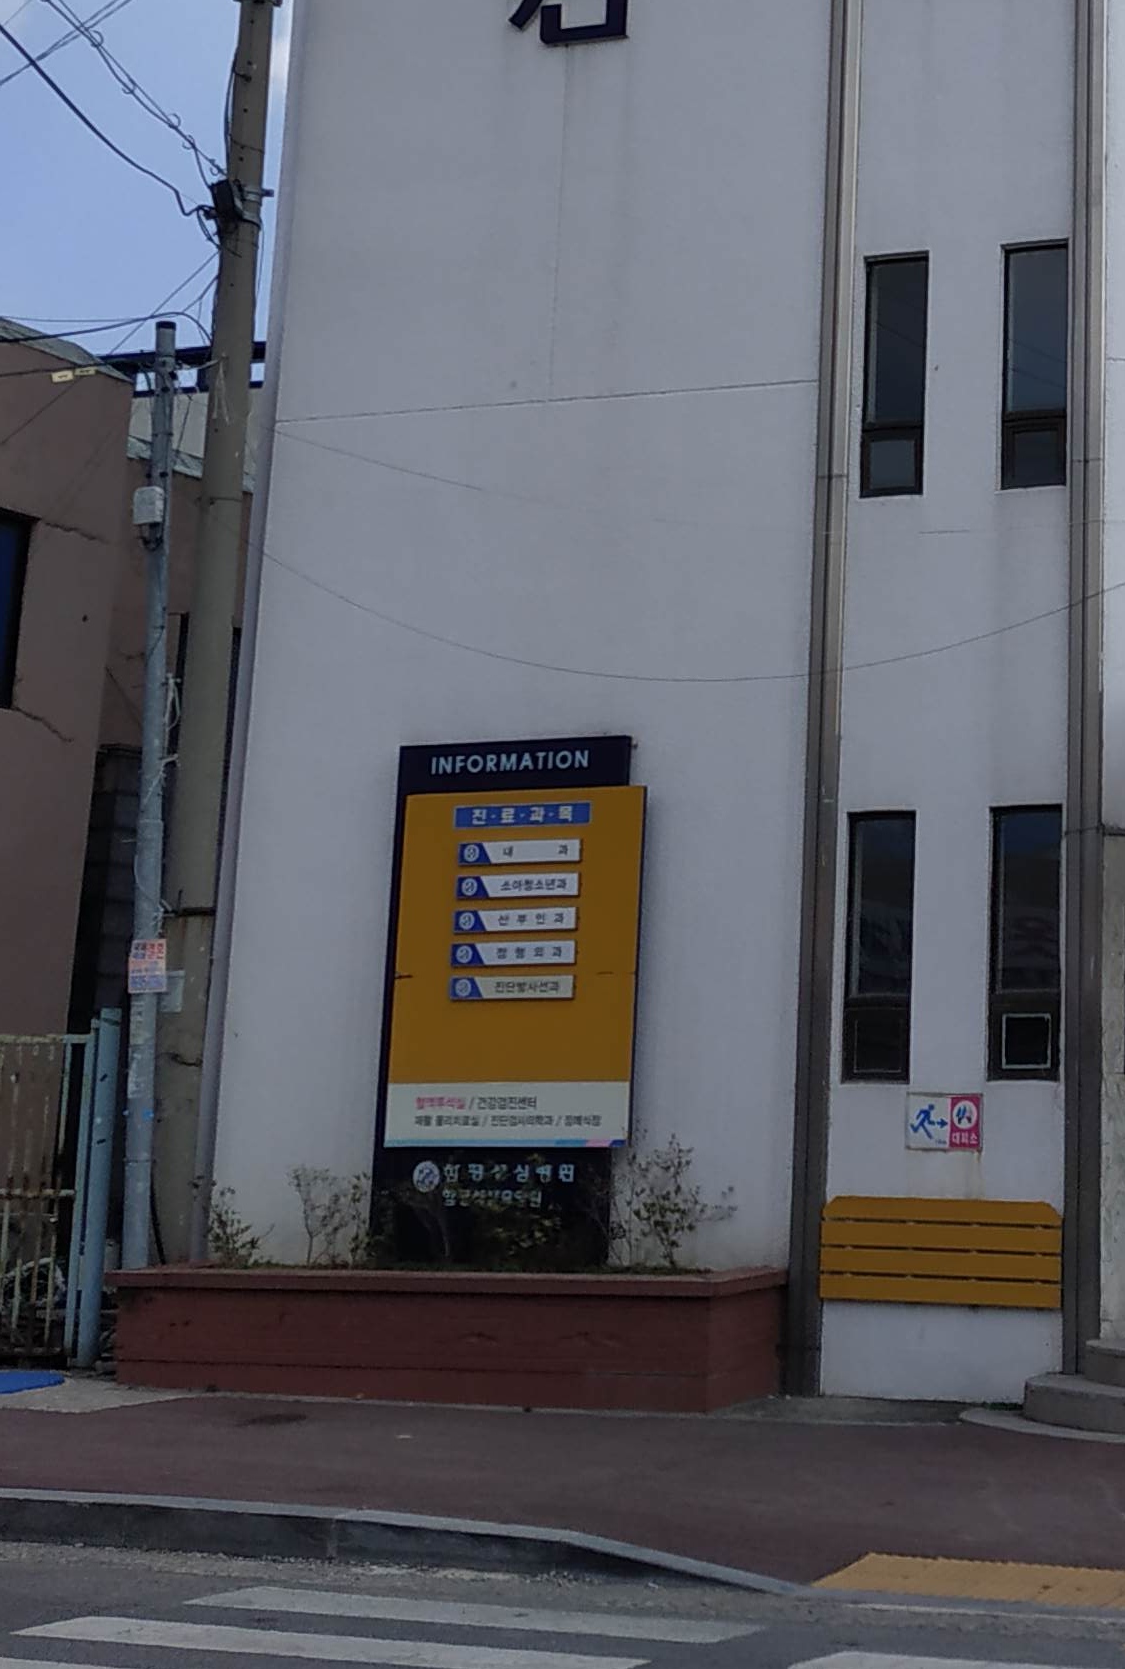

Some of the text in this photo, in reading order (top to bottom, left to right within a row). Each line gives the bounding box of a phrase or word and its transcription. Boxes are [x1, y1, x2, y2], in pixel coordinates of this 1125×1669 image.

[430, 749, 590, 776] INFORMATION
[499, 878, 567, 892] 소아청소년과
[477, 1095, 538, 1110] 건강검진센터
[951, 1130, 979, 1145] 대피소
